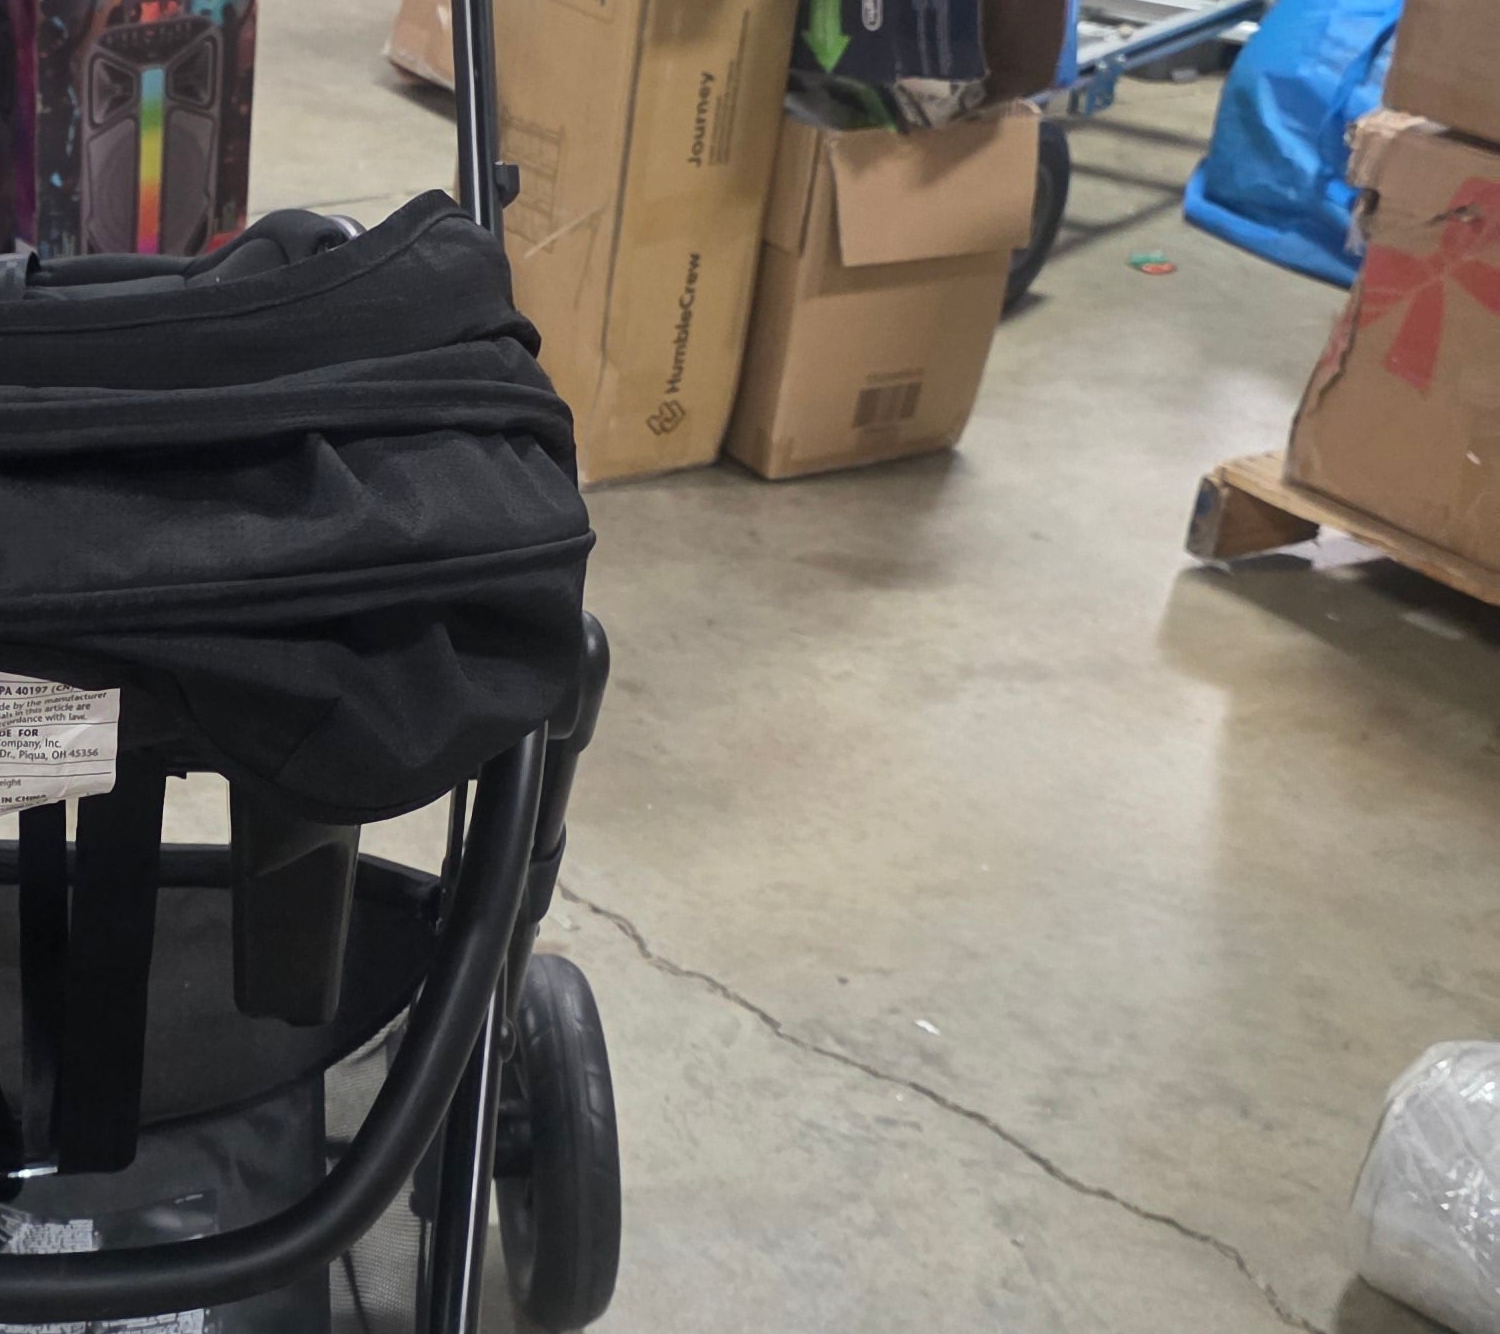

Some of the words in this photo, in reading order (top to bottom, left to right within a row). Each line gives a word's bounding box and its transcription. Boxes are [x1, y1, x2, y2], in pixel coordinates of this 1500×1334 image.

[686, 70, 716, 170] Journey
[665, 251, 702, 394] HumbleCrew
[15, 685, 47, 696] 40197
[12, 700, 25, 712] by
[26, 699, 42, 708] the
[44, 692, 108, 705] manufacturer
[15, 709, 23, 717] in
[25, 706, 42, 716] this
[44, 702, 74, 713] article
[75, 703, 91, 712] are
[45, 712, 66, 722] with
[68, 712, 87, 722] law.
[18, 728, 39, 737] FOR
[44, 738, 62, 749] Inc.
[18, 749, 48, 762] Piqua,
[51, 750, 67, 760] OH
[68, 748, 99, 758] 45356
[0, 795, 13, 803] IN
